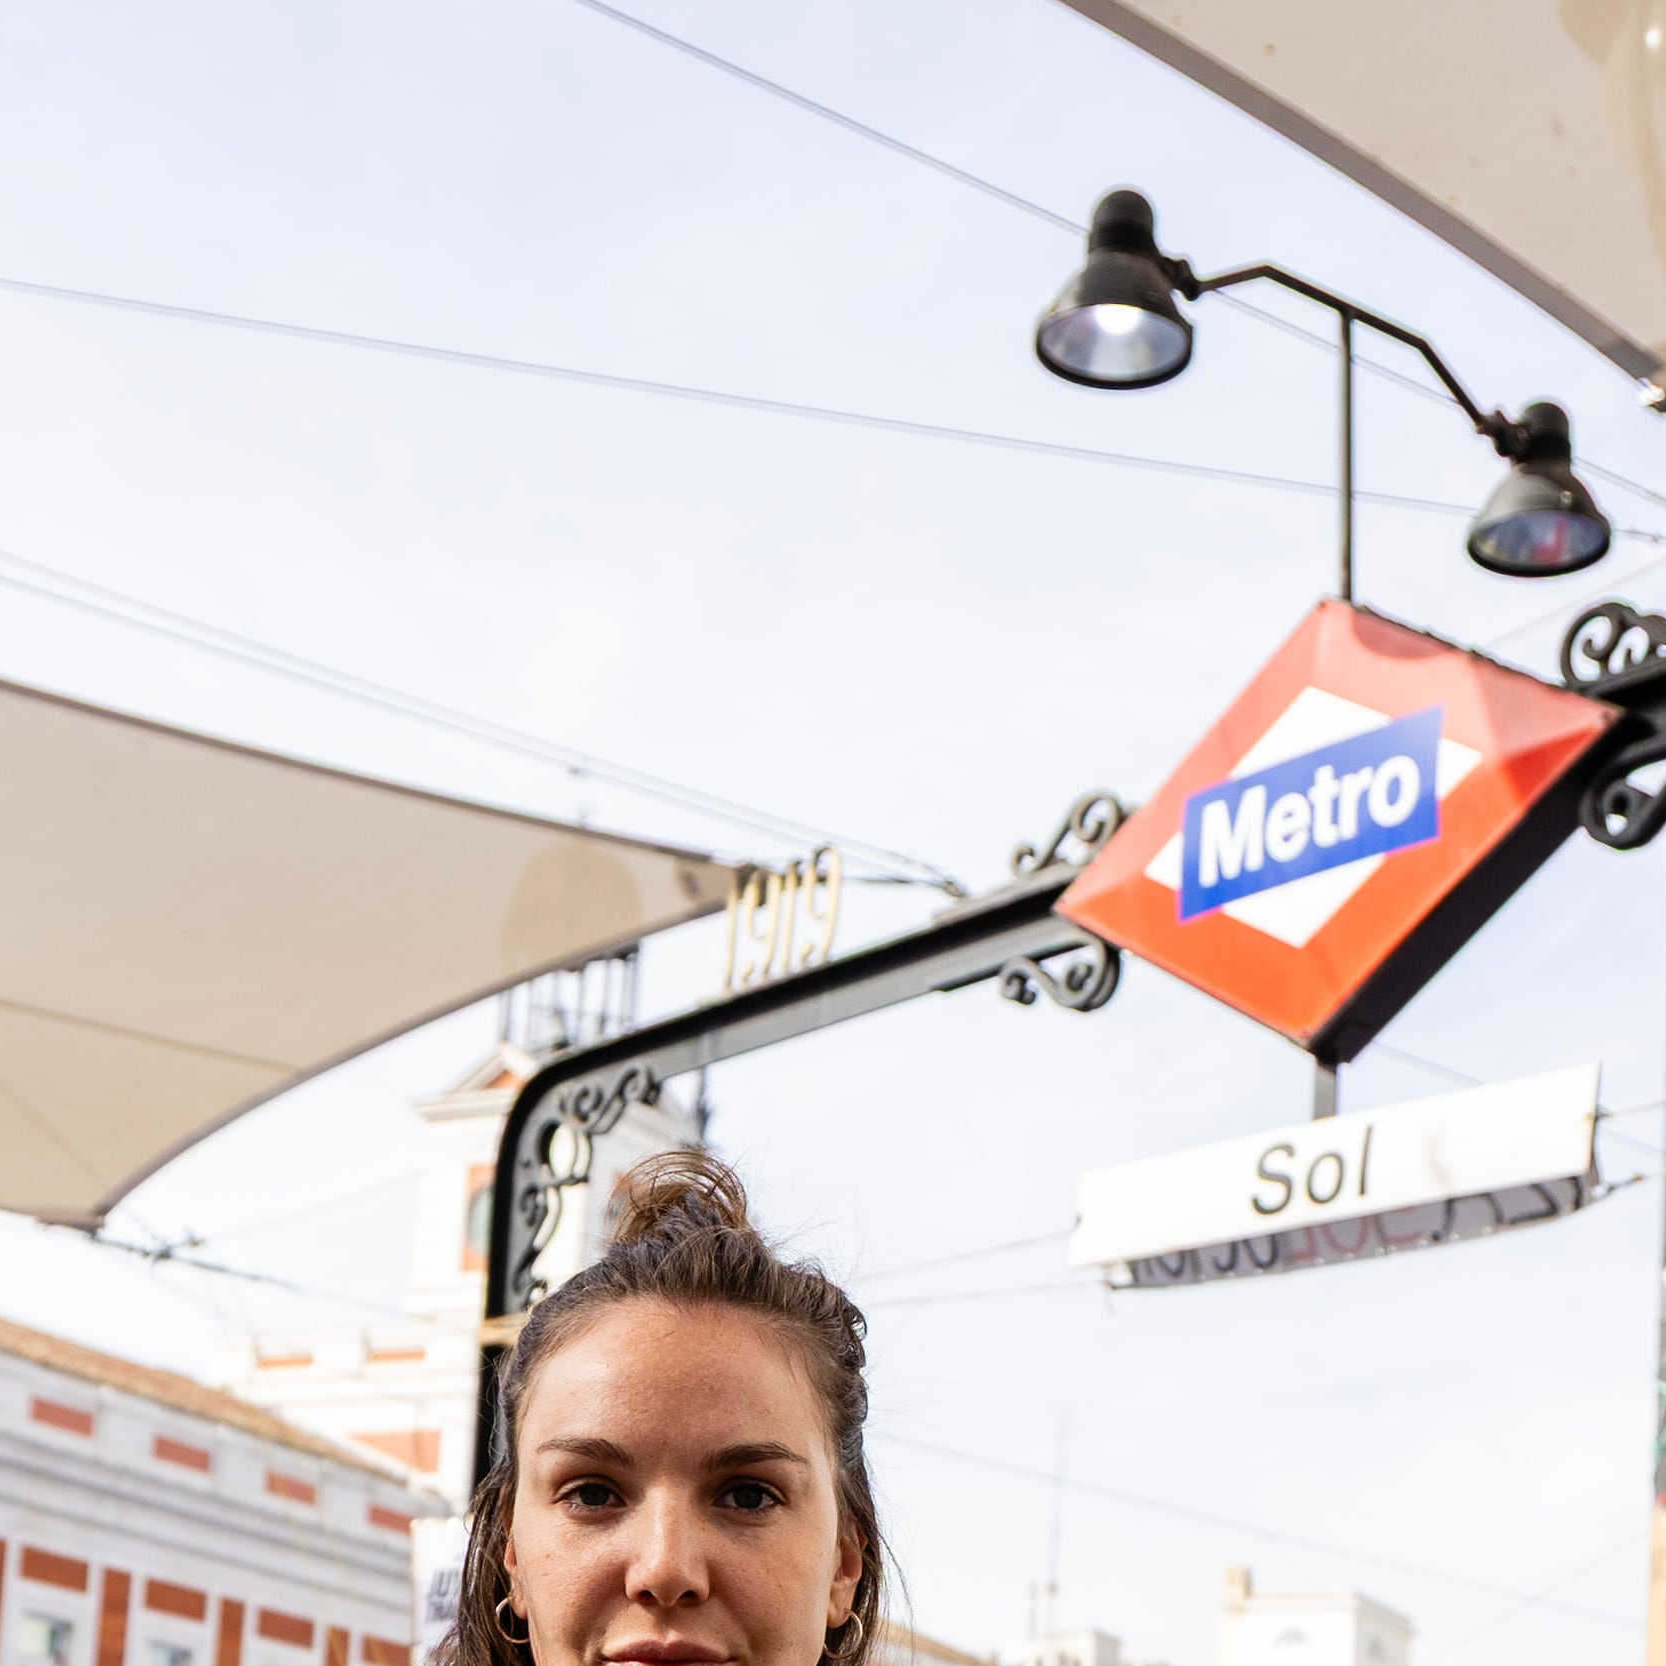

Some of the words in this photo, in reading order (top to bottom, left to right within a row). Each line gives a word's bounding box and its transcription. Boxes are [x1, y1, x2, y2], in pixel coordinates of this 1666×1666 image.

[1199, 753, 1421, 888] Metro
[724, 846, 841, 993] 1919
[1250, 1125, 1374, 1215] Sol
